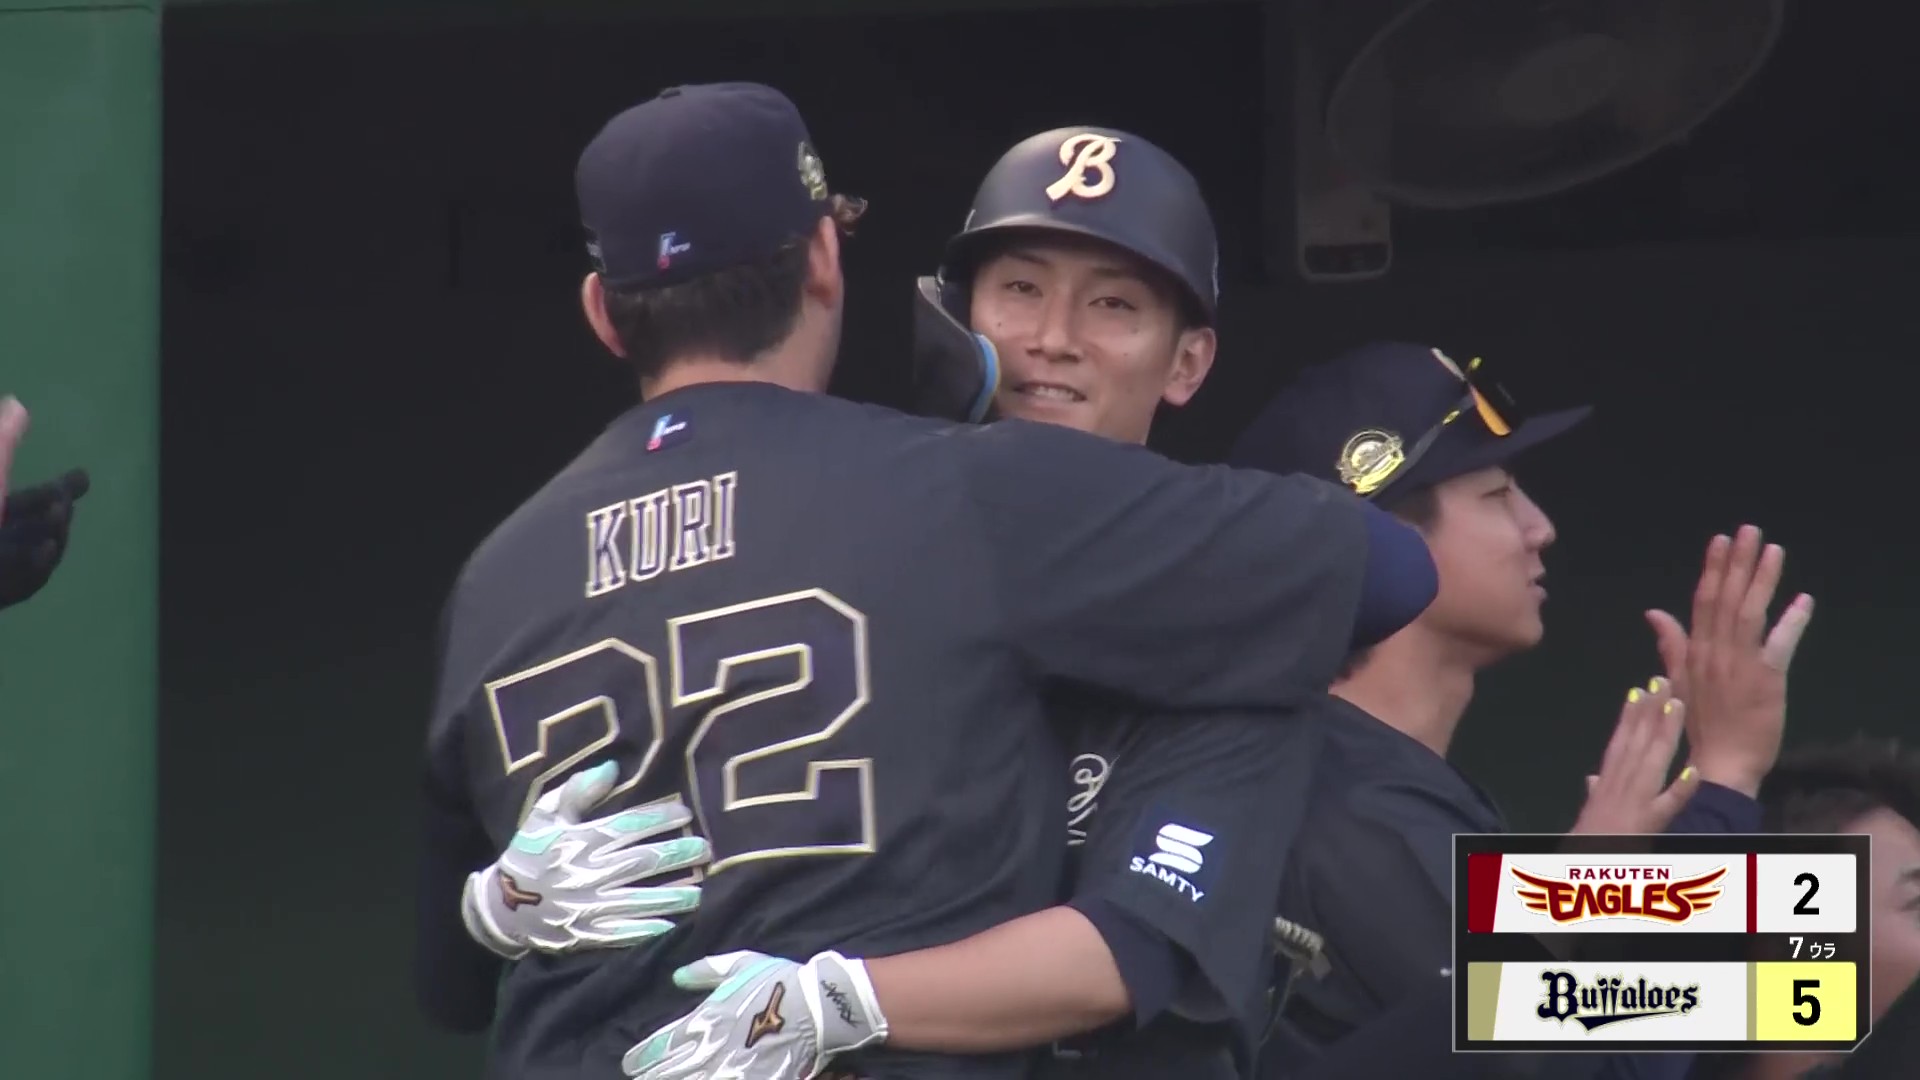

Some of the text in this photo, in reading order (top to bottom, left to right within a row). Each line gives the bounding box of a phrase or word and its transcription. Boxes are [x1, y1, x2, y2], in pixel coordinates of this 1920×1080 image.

[1046, 133, 1122, 201] B
[586, 471, 738, 598] KURI
[484, 587, 876, 875] 22
[1129, 856, 1205, 903] SAMTY
